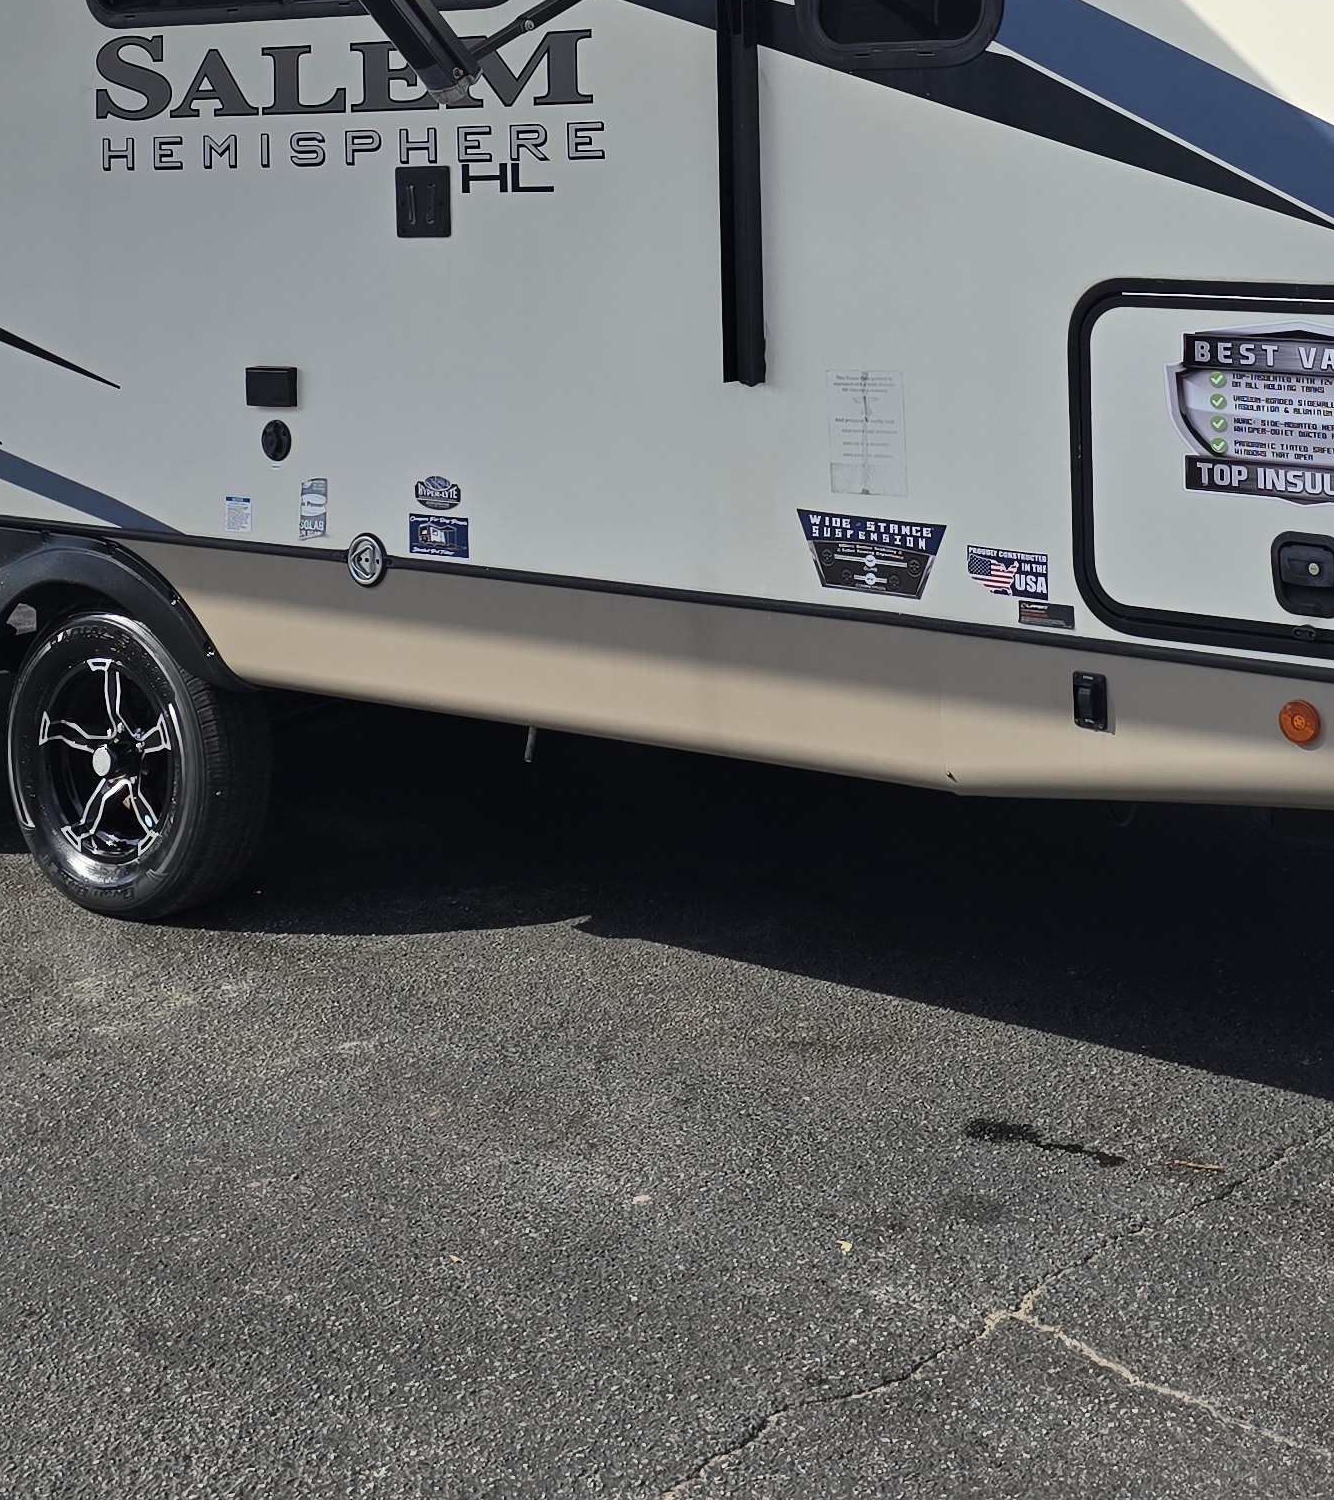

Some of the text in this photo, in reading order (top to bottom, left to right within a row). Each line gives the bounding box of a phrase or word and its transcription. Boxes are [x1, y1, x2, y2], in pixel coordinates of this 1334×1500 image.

[95, 28, 594, 121] SALEM
[102, 120, 606, 172] HEMISPHERE
[461, 161, 555, 194] HL
[1194, 340, 1278, 367] BEST
[1295, 376, 1316, 385] WITH
[1280, 443, 1309, 453] TINTED
[1196, 462, 1248, 487] TOP
[811, 525, 926, 551] SUSPENSION
[866, 521, 932, 538] STANCE
[998, 551, 1047, 563] CONSTRUCTED
[1021, 562, 1047, 574] IN THE
[1014, 573, 1047, 594] USA
